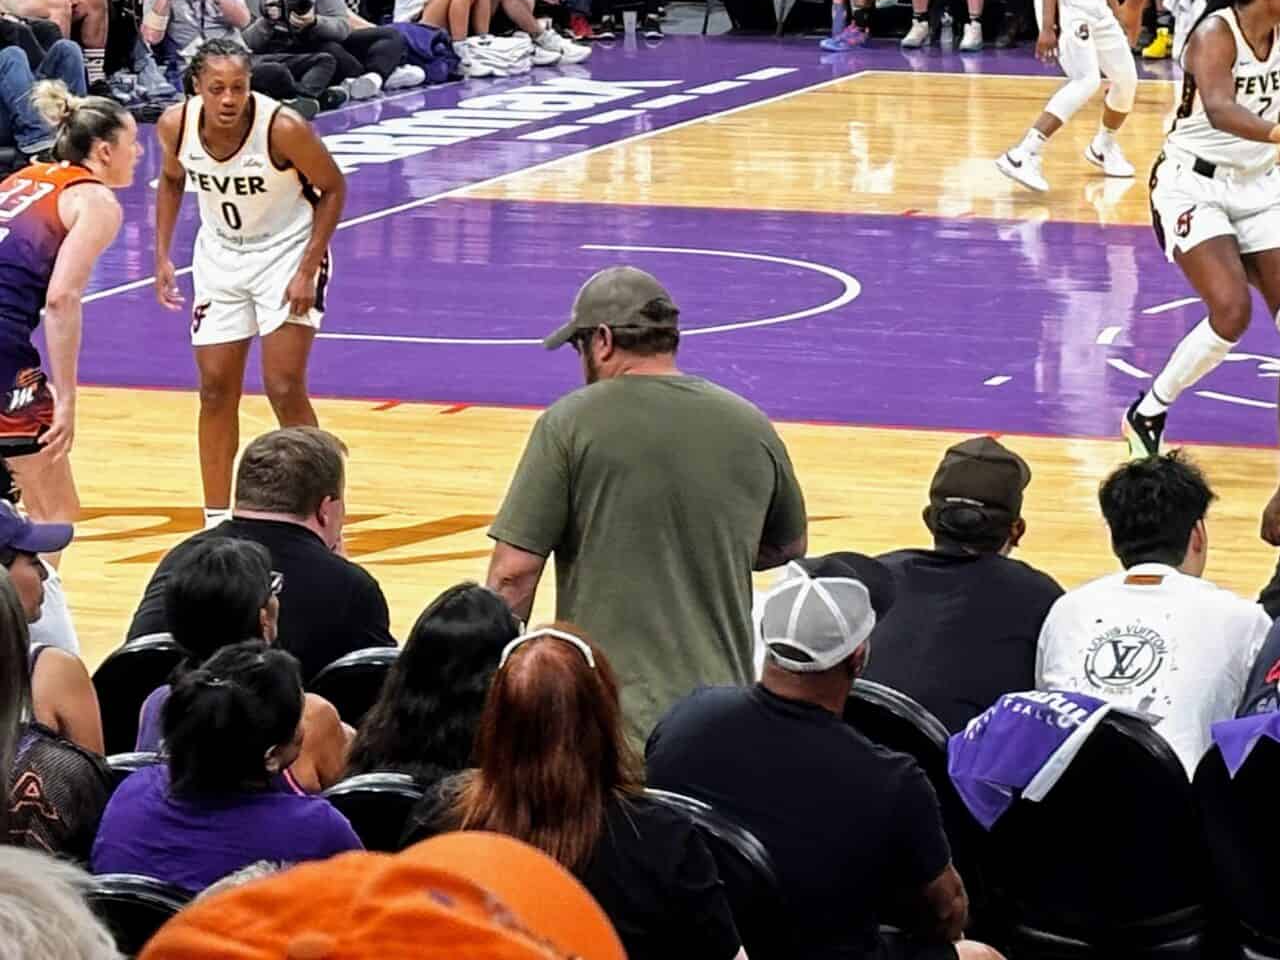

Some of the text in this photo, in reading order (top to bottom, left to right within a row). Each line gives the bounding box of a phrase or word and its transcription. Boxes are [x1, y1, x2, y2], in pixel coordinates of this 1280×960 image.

[1258, 97, 1272, 117] 7
[188, 169, 267, 195] FEVER
[221, 201, 242, 230] 0
